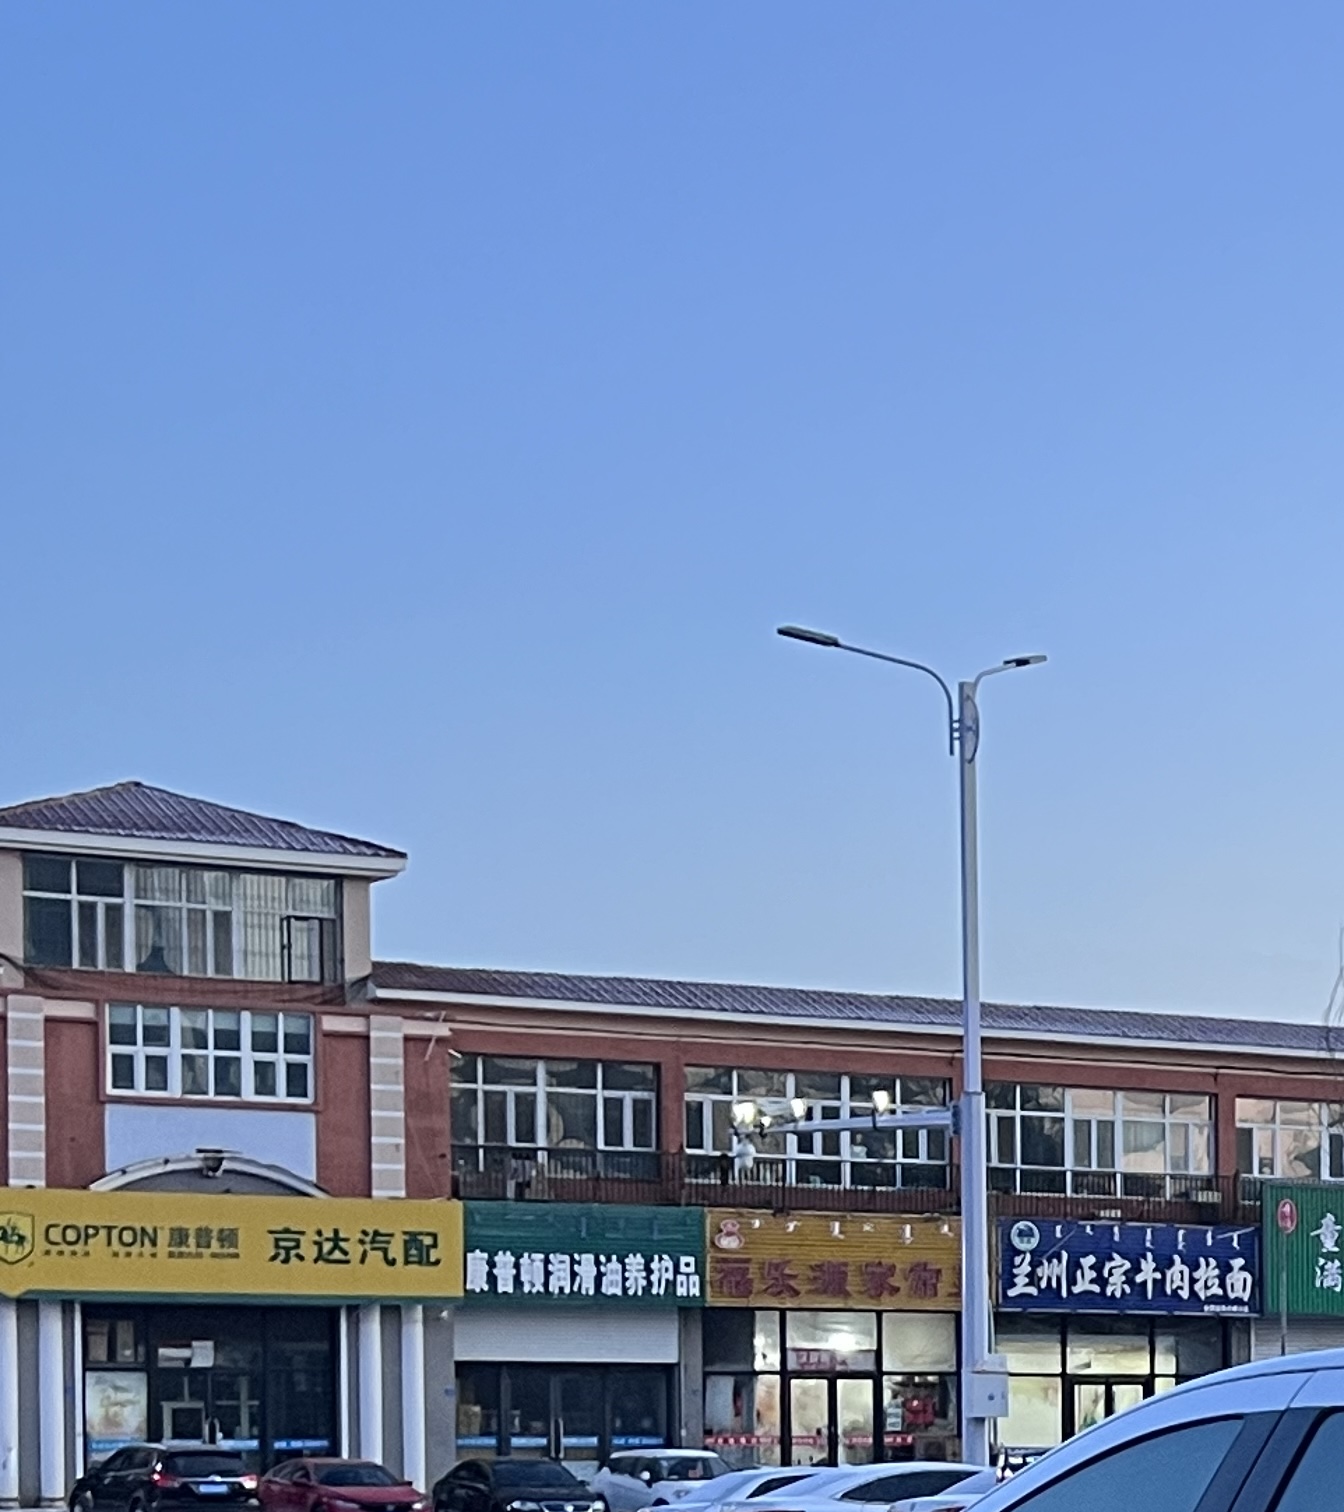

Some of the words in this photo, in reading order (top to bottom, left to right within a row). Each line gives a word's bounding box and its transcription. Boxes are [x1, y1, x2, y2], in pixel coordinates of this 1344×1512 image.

[44, 1223, 158, 1248] COPTON
[168, 1225, 240, 1250] 康普顿
[266, 1227, 441, 1267] 京达汽配
[466, 1249, 700, 1297] 康普顿润滑油养护品
[1007, 1250, 1253, 1301] 兰州正宗牛肉拉面
